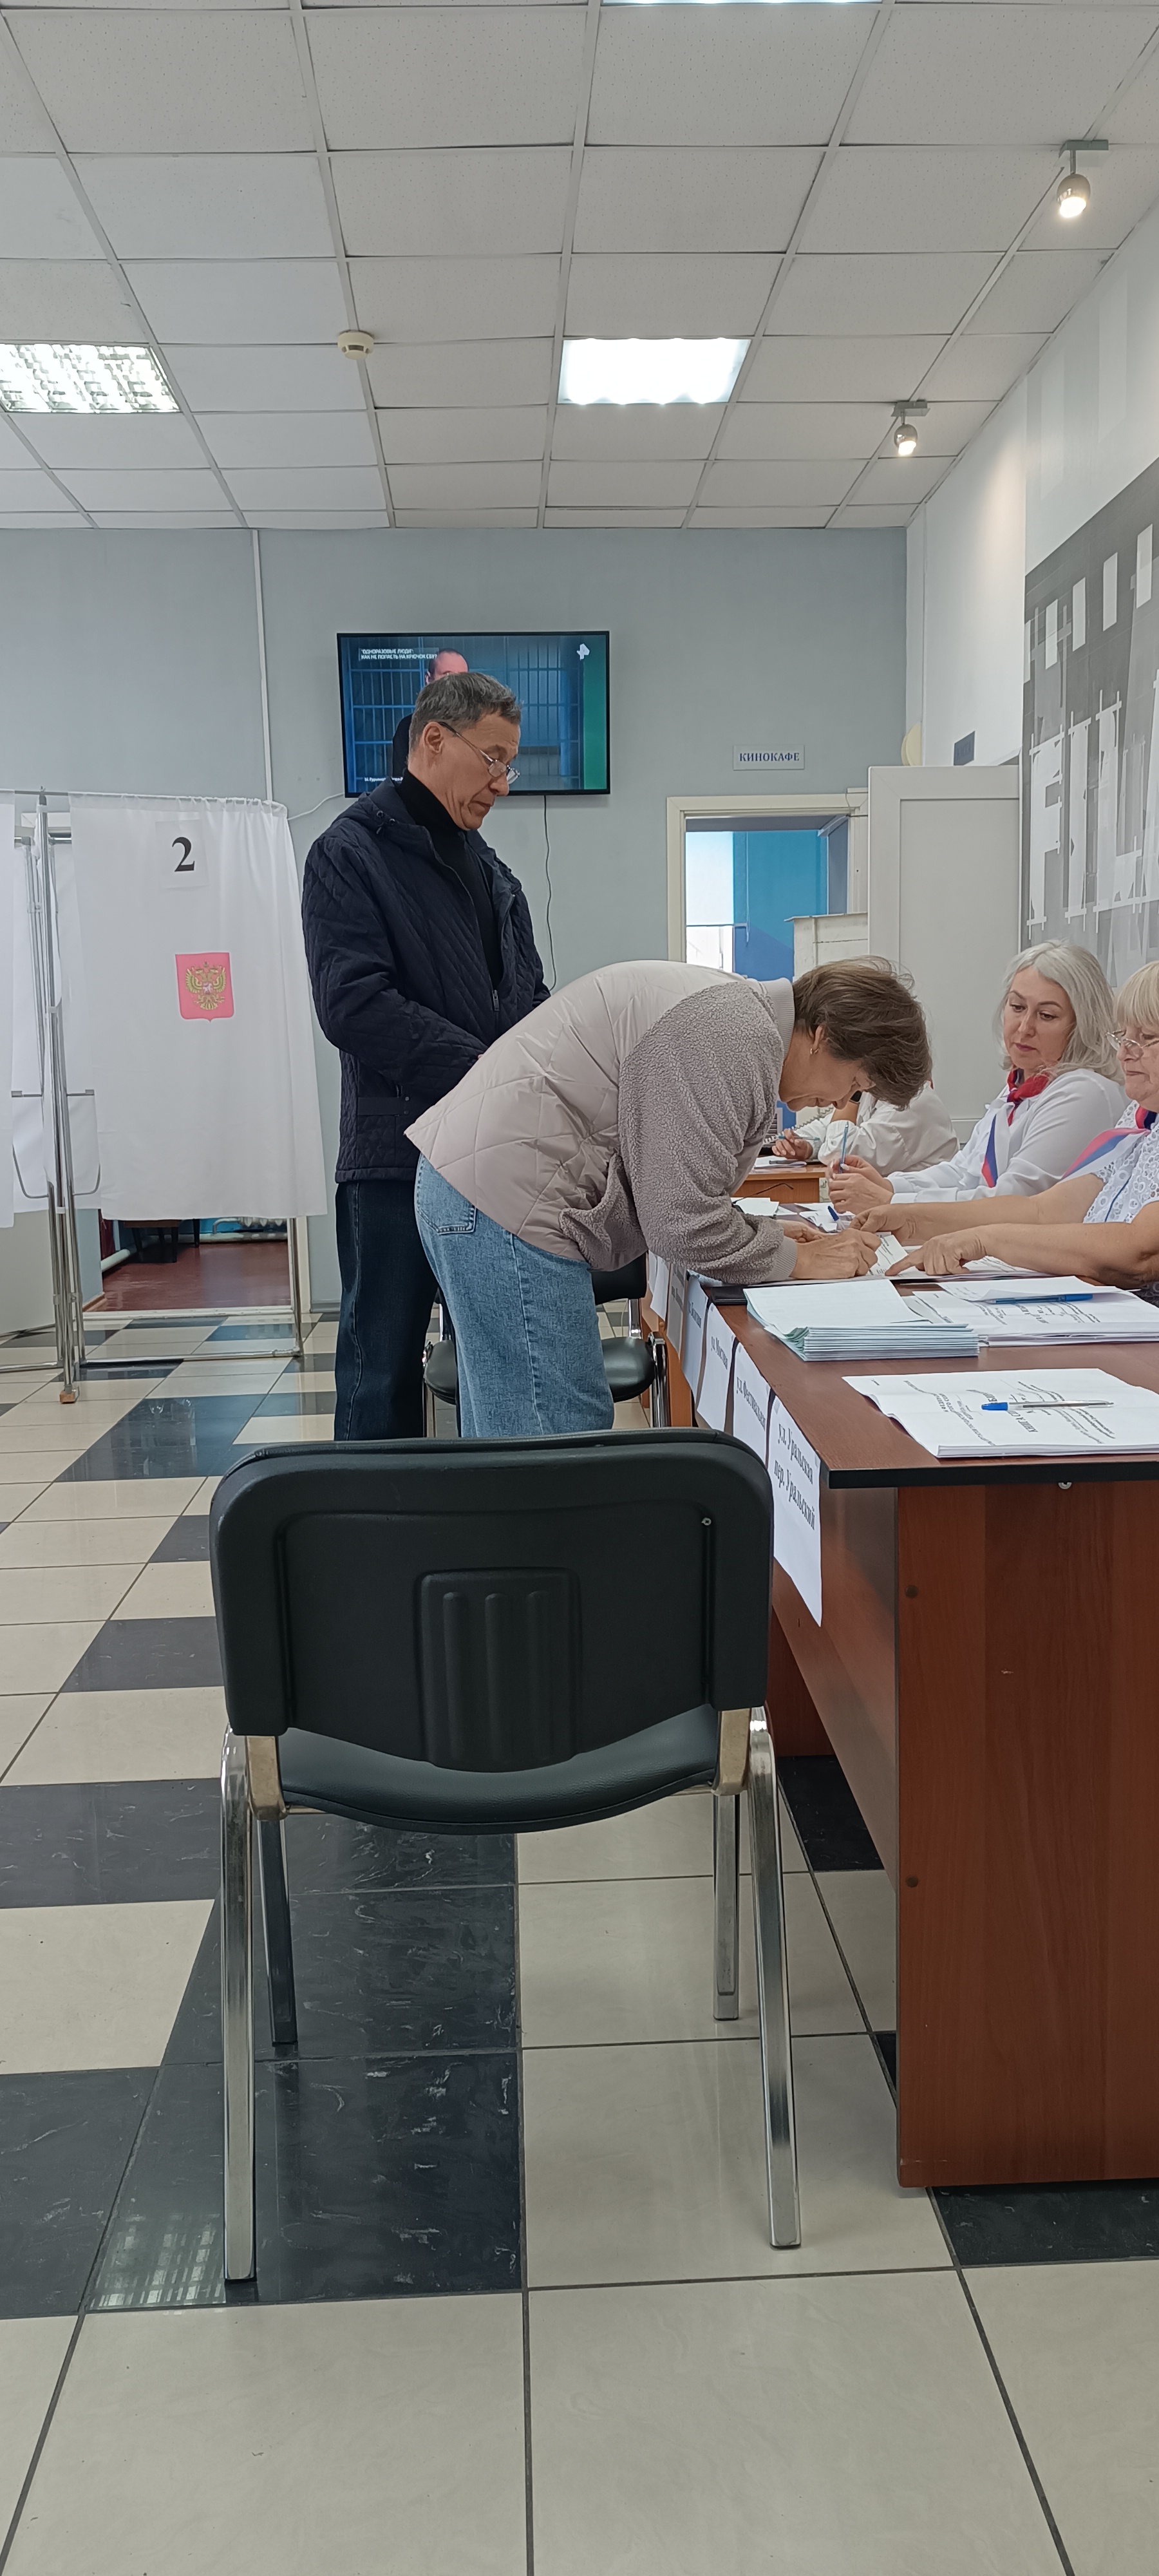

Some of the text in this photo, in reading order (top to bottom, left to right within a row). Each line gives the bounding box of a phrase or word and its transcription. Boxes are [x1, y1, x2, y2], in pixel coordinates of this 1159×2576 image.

[739, 752, 800, 762] КИНОКАФЕ
[171, 836, 196, 872] 2
[743, 1380, 766, 1432] Фестивальная
[777, 1421, 814, 1484] ул. Уральская
[774, 1458, 816, 1531] пер. Уральский
